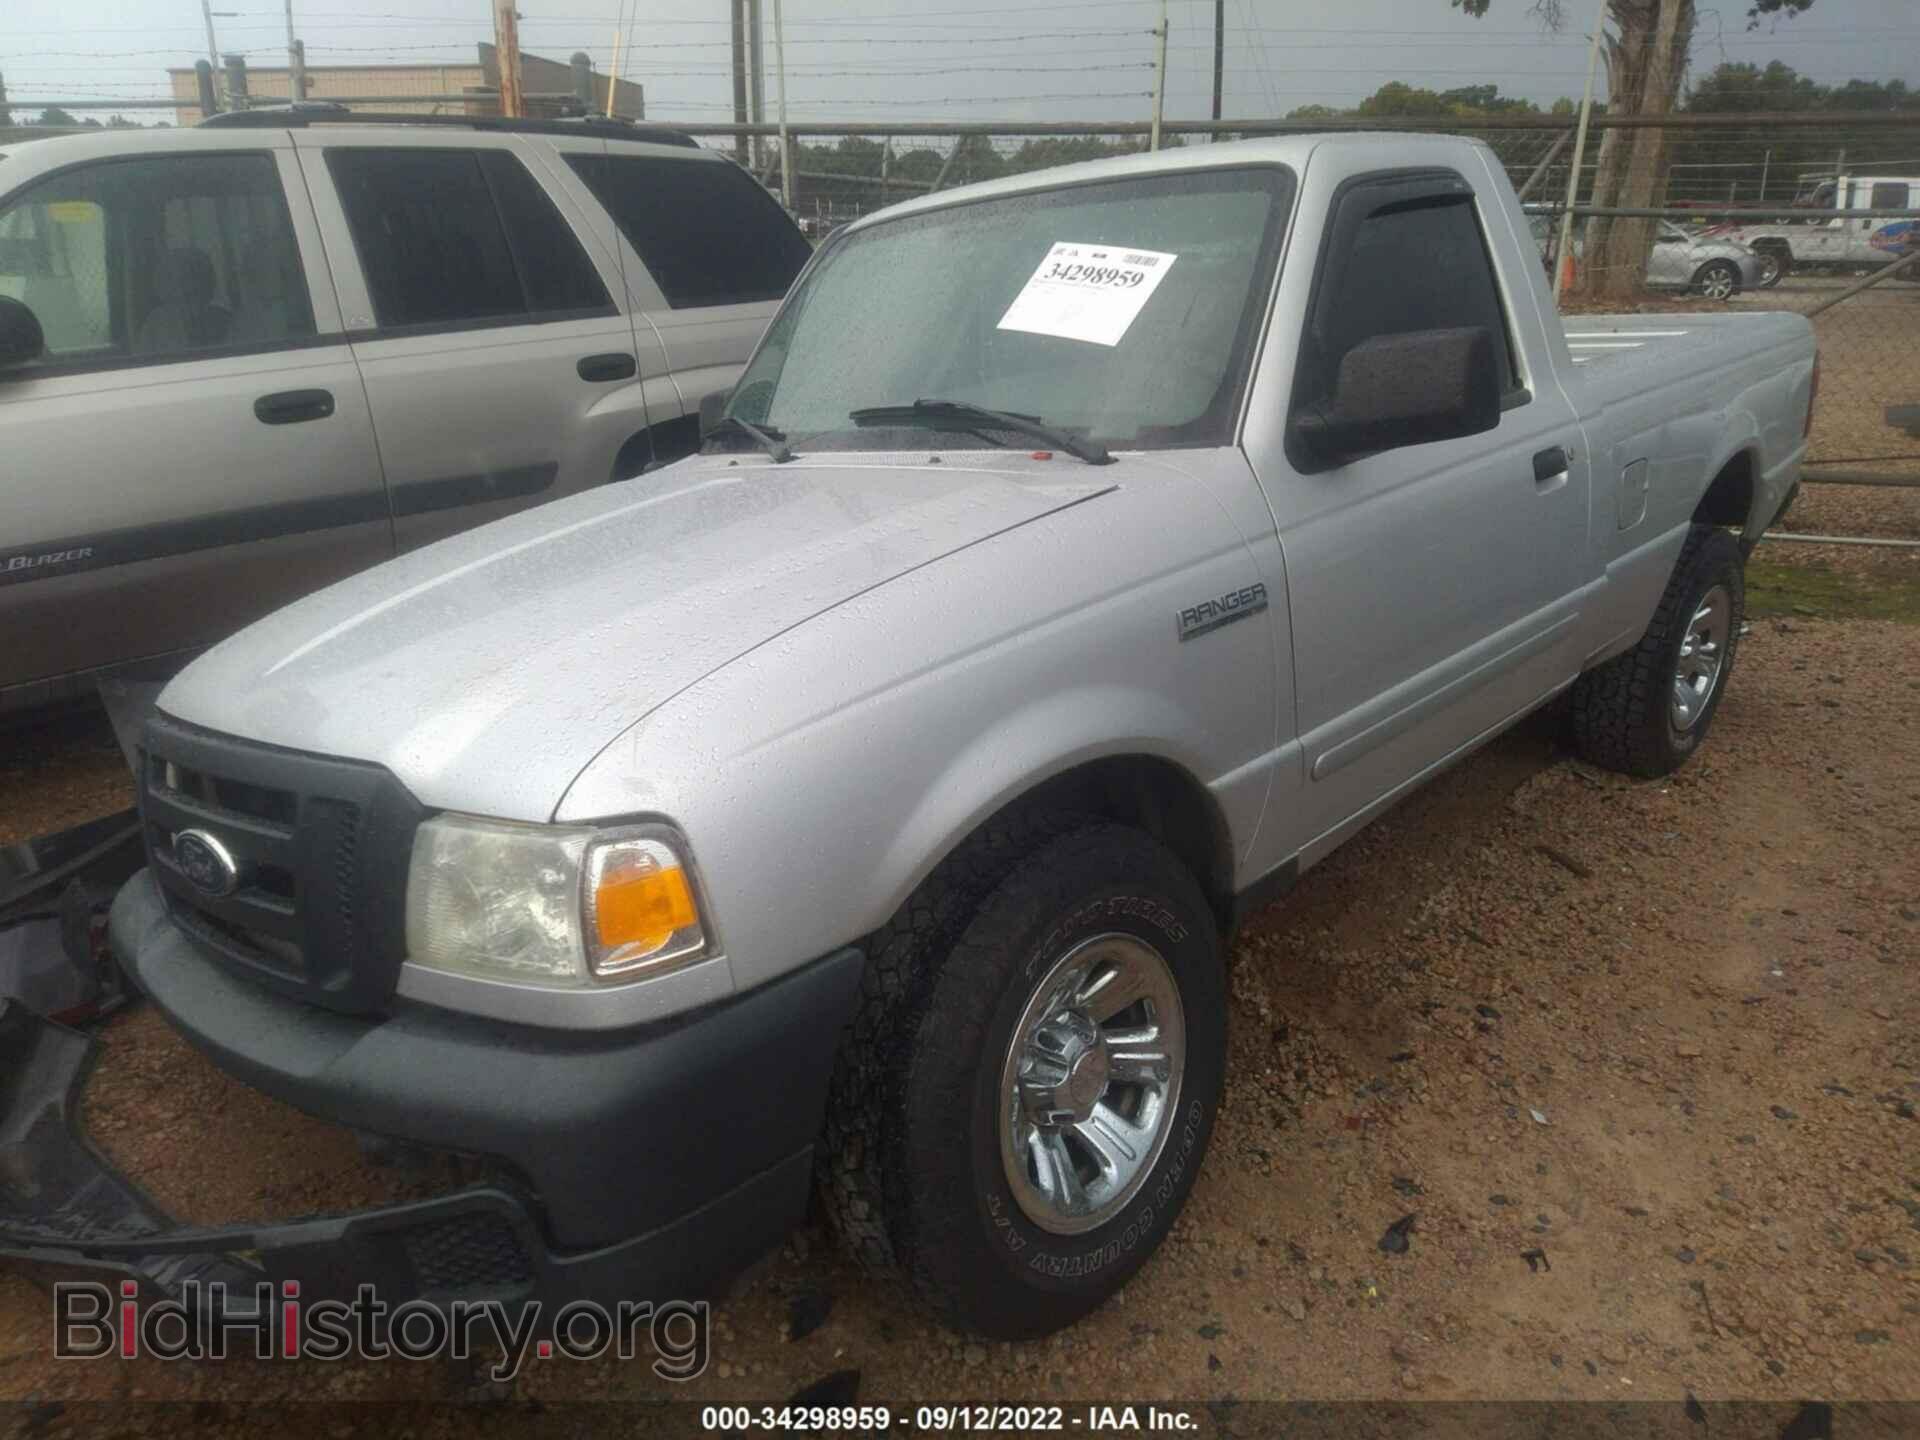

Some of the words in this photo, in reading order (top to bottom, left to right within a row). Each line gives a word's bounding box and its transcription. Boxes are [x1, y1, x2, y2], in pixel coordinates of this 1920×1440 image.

[1043, 262, 1145, 289] 34298959
[8, 547, 94, 570] BLAZER
[1180, 581, 1267, 627] RANGER
[1029, 1205, 1153, 1277] COUNTRY
